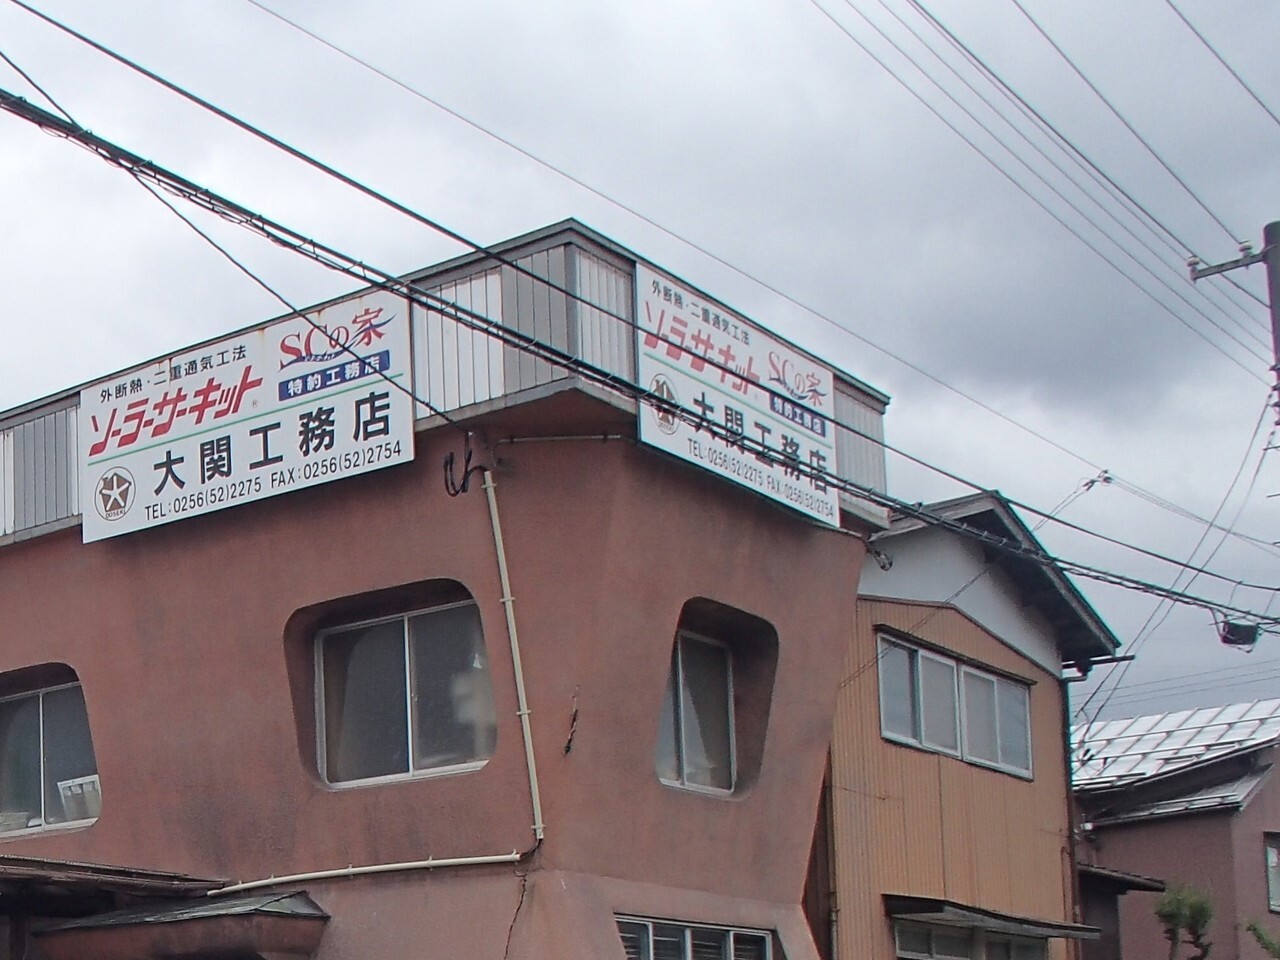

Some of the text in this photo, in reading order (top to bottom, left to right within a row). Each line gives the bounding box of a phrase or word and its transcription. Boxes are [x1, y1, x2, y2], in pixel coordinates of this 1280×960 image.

[287, 355, 381, 397] 特約工務店
[153, 391, 391, 496] 大関工務店
[693, 392, 827, 495] 大関工務店
